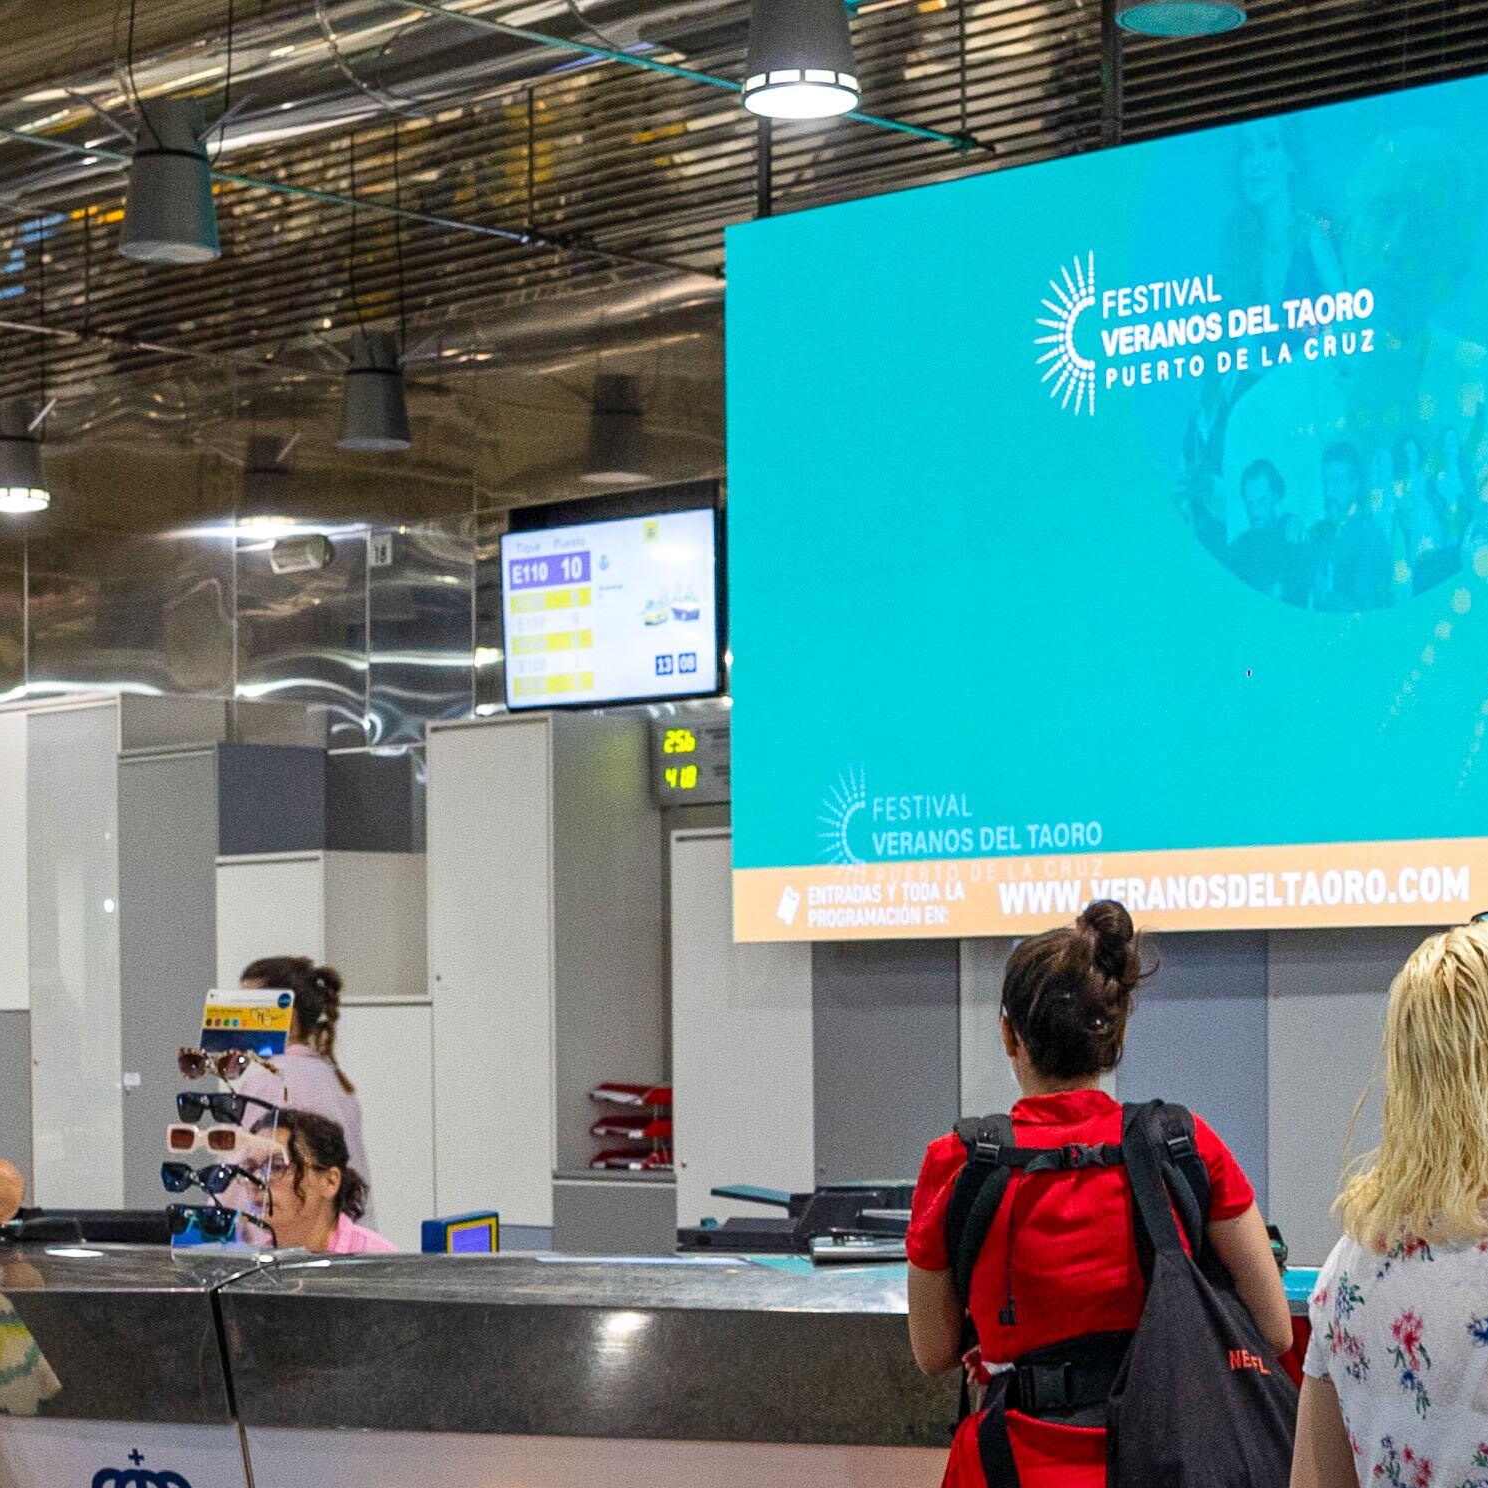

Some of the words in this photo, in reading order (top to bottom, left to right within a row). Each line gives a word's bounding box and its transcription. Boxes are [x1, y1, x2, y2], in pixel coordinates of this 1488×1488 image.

[1102, 274, 1222, 319] FESTIVAL
[1101, 312, 1222, 357] VERANOS
[1228, 304, 1279, 338] DEL
[1282, 288, 1374, 330] TAORO
[1106, 354, 1205, 389] PUERTO
[1217, 348, 1249, 373] DE
[1261, 342, 1293, 367] LA
[1303, 329, 1375, 361] CRUZ
[512, 561, 548, 585] E110
[561, 556, 583, 580] 10
[872, 793, 972, 822] FESTIVAL
[872, 828, 973, 856] VERANOS
[980, 825, 1022, 851] DEL
[1027, 820, 1103, 849] TAORO
[875, 861, 959, 885] PUERTO
[970, 860, 995, 881] DE
[1008, 859, 1032, 881] LA
[1044, 857, 1103, 880] CRUZ
[807, 882, 881, 906] ENTRADAS
[886, 883, 895, 903] Y
[901, 881, 939, 902] TODA
[945, 880, 966, 900] LA
[998, 865, 1470, 916] WWW.VERANOSDELTAORO.COM
[807, 902, 921, 928] PROGRAMACIÓN
[925, 906, 949, 925] EN:
